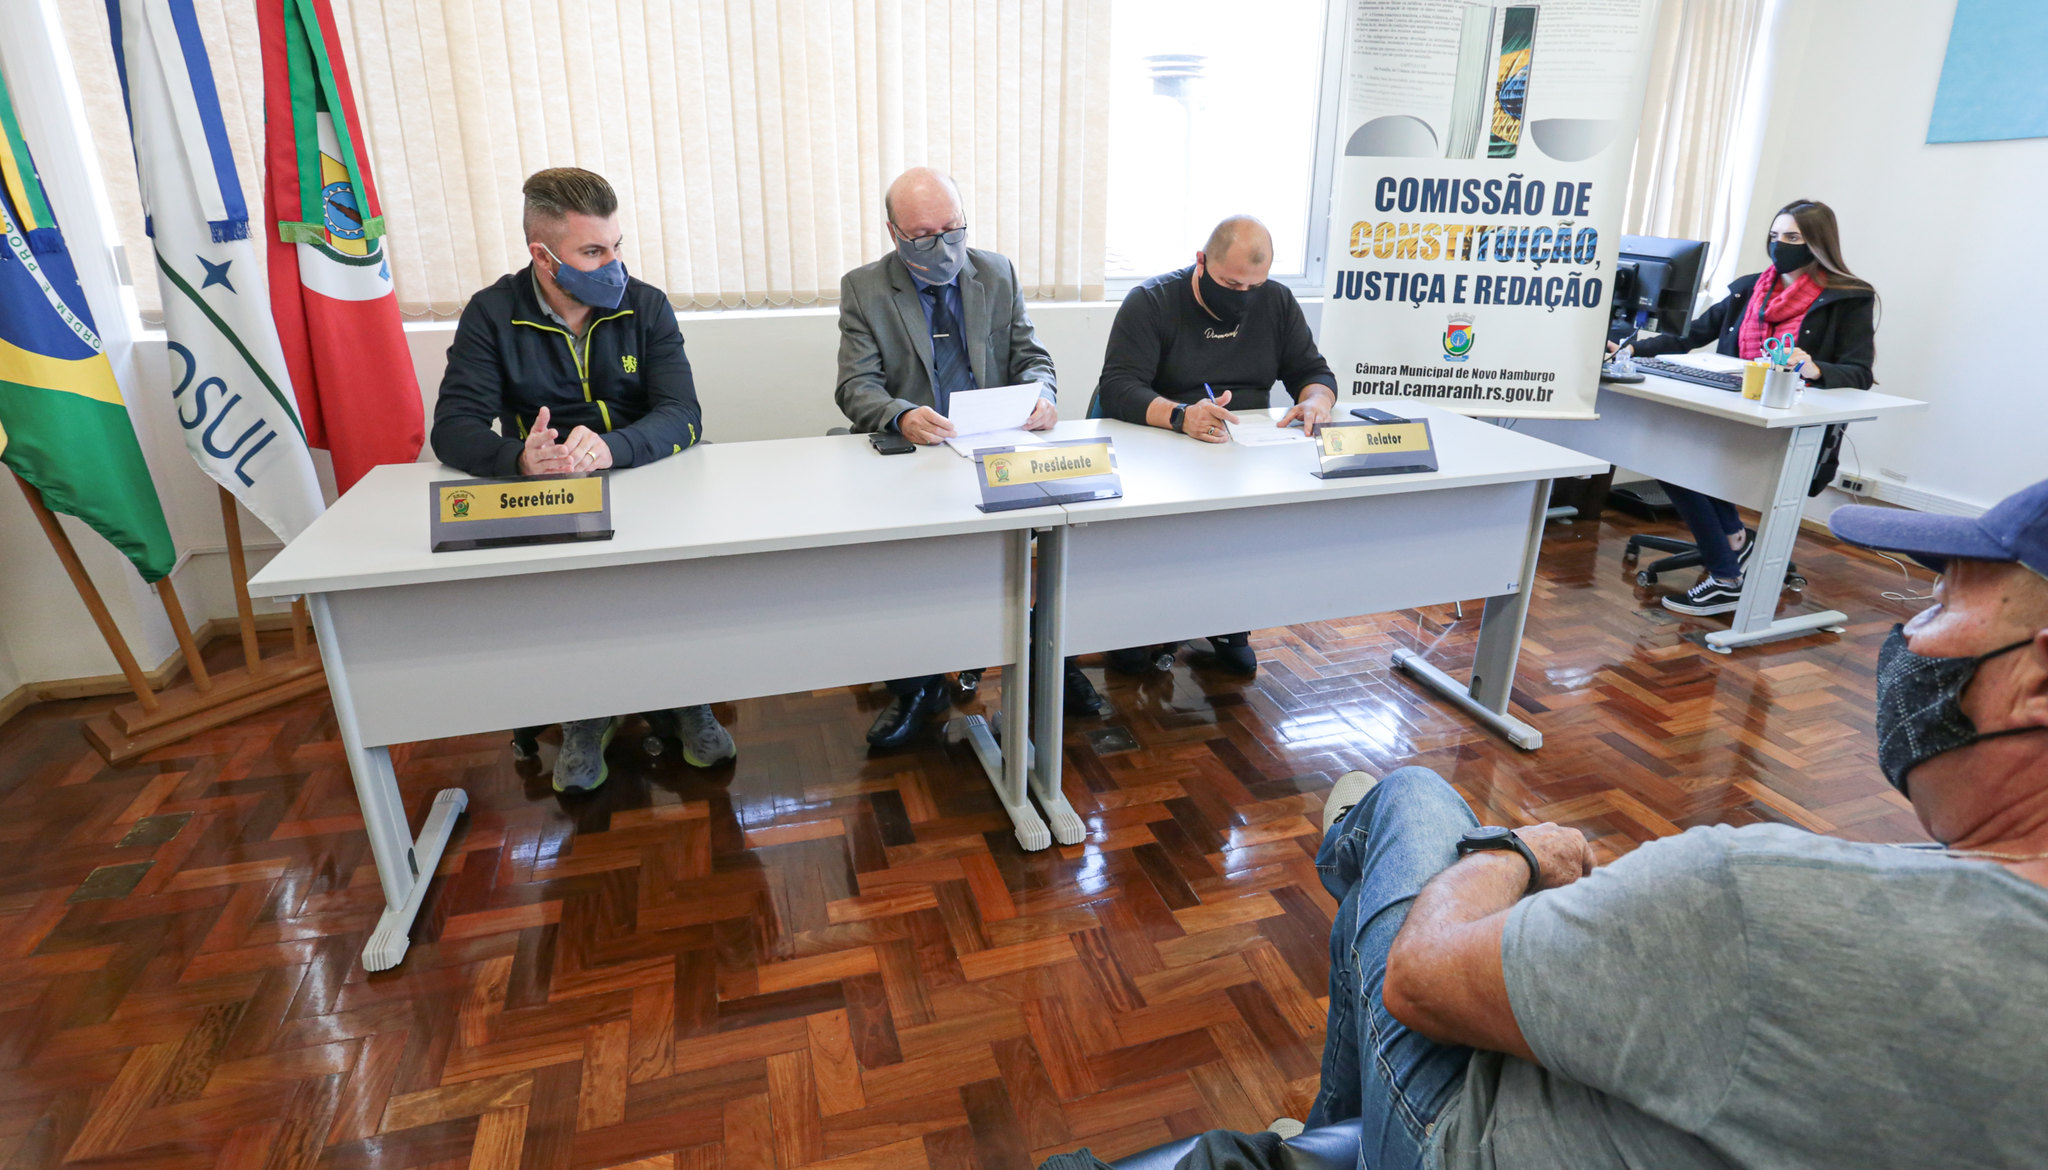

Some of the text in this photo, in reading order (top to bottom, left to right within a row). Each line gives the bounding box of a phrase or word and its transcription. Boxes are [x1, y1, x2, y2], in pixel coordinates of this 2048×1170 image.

[1374, 173, 1592, 217] COMISSÃO DE
[1349, 219, 1601, 271] CONSTITUIÇÃO,
[43, 282, 51, 293] E
[1333, 270, 1603, 313] JUSTIÇA E REDAÇÃO
[56, 302, 101, 350] ORDEM
[1355, 362, 1555, 382] Câmara Municipal de Novo Hamburgo
[1352, 380, 1554, 403] portal.camaranh.rs.gov.br
[1366, 432, 1402, 446] Relator
[1030, 455, 1092, 474] Presidente
[499, 488, 575, 510] Secretário
